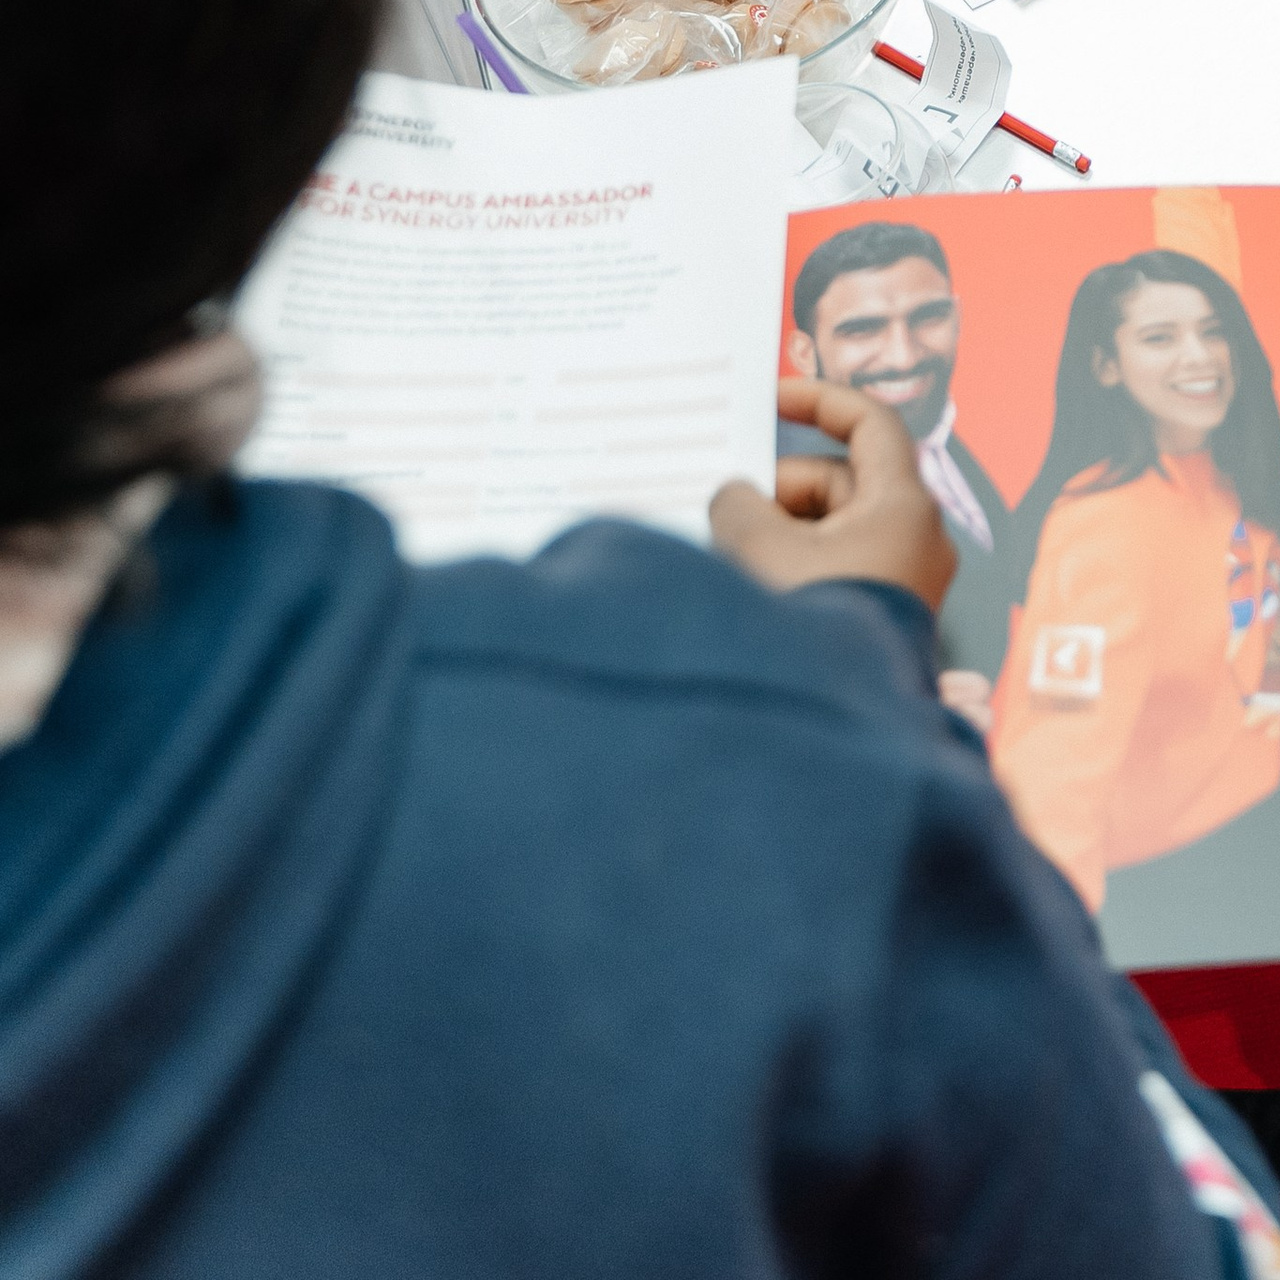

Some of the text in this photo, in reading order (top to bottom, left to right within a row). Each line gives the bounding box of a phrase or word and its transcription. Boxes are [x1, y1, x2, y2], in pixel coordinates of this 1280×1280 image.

[368, 182, 476, 210] CAMPUS
[482, 182, 655, 210] AMBASSADOR
[361, 201, 479, 230] SYNERGY
[486, 206, 628, 231] UNIVERSITY
